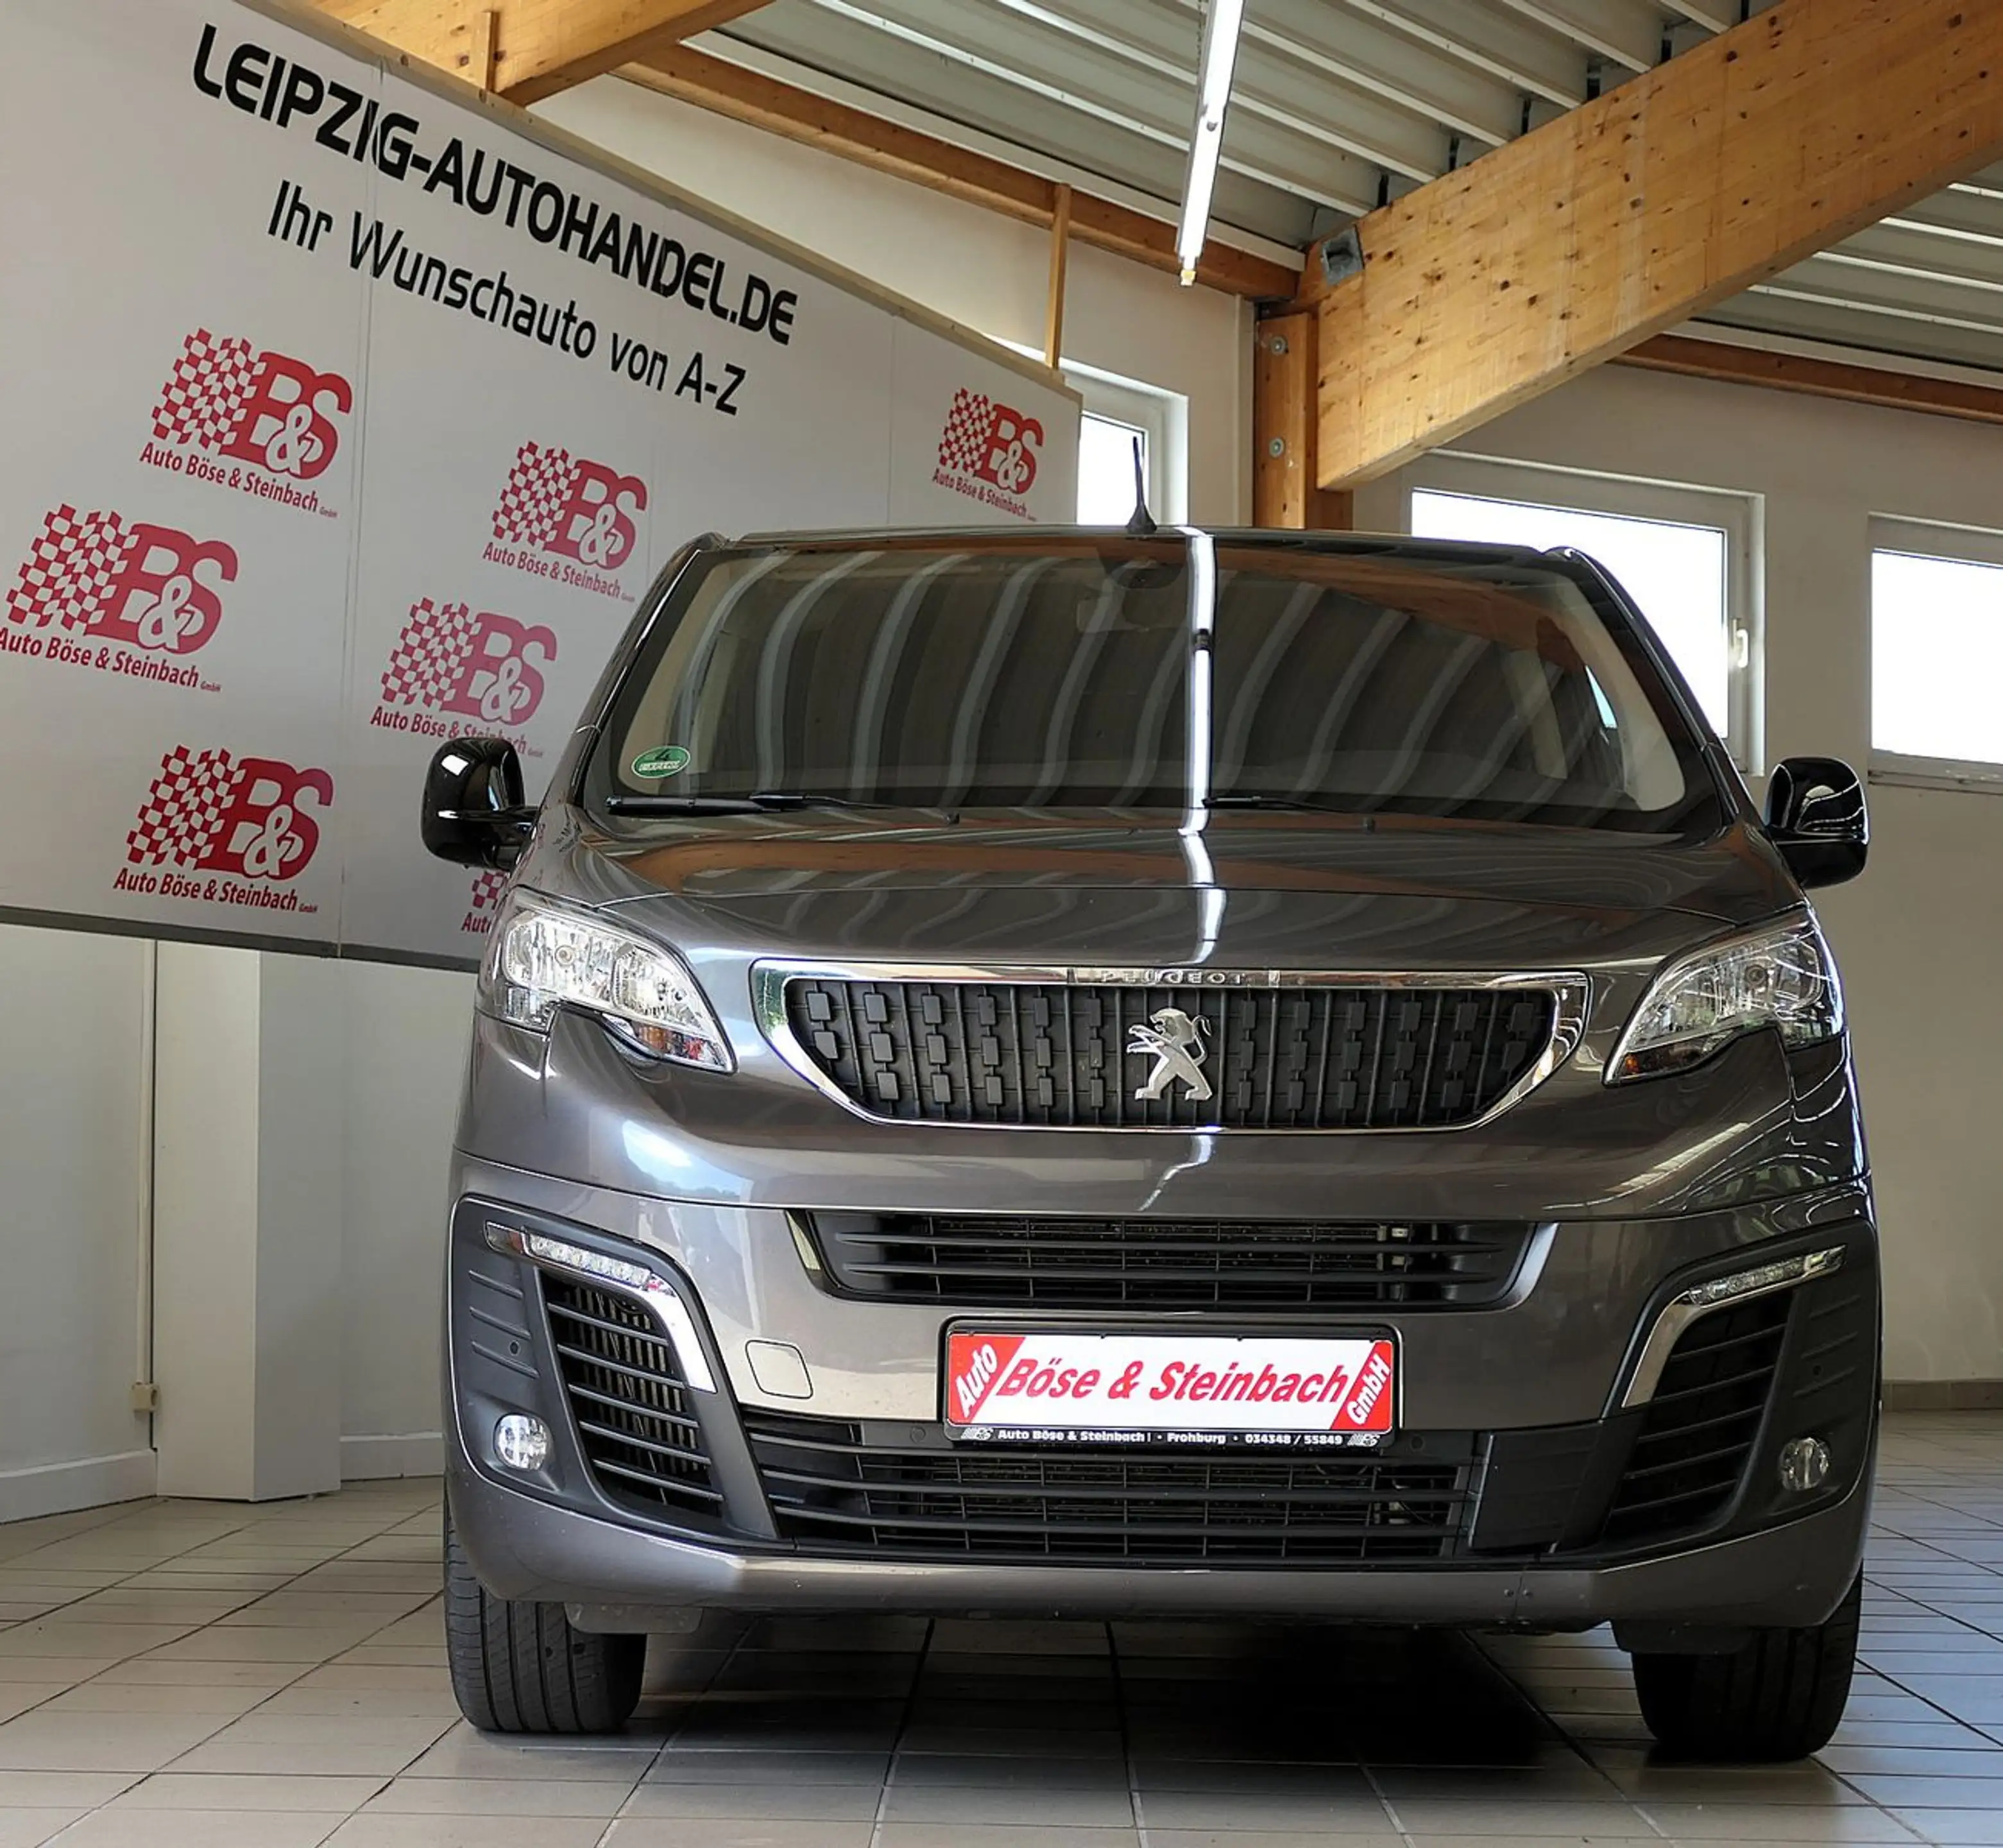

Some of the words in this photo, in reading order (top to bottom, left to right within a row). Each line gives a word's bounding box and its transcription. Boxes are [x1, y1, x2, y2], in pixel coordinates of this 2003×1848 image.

[192, 24, 797, 345] LEIPZIG-AUTOHANDEL.DE
[268, 180, 332, 251] Ihr
[348, 211, 597, 359] Wunschauto
[611, 332, 667, 391] von
[675, 352, 746, 416] A-Z
[140, 442, 182, 471] Auto
[185, 454, 226, 484] Böse
[228, 468, 242, 489] &
[243, 472, 319, 512] Steinbach
[482, 542, 515, 566] Auto
[517, 552, 549, 577] Böse
[549, 561, 560, 580] &
[562, 565, 620, 598] Steinbach
[0, 627, 42, 656] Auto
[46, 637, 92, 666] Böse
[95, 647, 110, 670] &
[112, 651, 199, 687] Steinbach
[370, 706, 408, 730] Auto
[411, 714, 447, 737] Böse
[448, 721, 460, 738] &
[113, 868, 157, 893] Auto
[158, 873, 201, 898] Böse
[203, 879, 217, 901] &
[218, 881, 298, 911] Steinbach
[1099, 969, 1245, 984] PEUGEOT
[955, 1344, 998, 1419] Auto
[996, 1357, 1101, 1398] Böse
[1108, 1361, 1142, 1399] &
[1150, 1361, 1348, 1403] Steinbach
[1347, 1353, 1391, 1425] GmbH
[998, 1430, 1029, 1439] Auto
[1032, 1429, 1064, 1441] Böse
[1067, 1431, 1077, 1441] &
[1080, 1431, 1145, 1442] Steinbach
[1167, 1432, 1226, 1444] Frohburg
[1245, 1433, 1291, 1444] 034348
[1304, 1435, 1343, 1445] 55849
